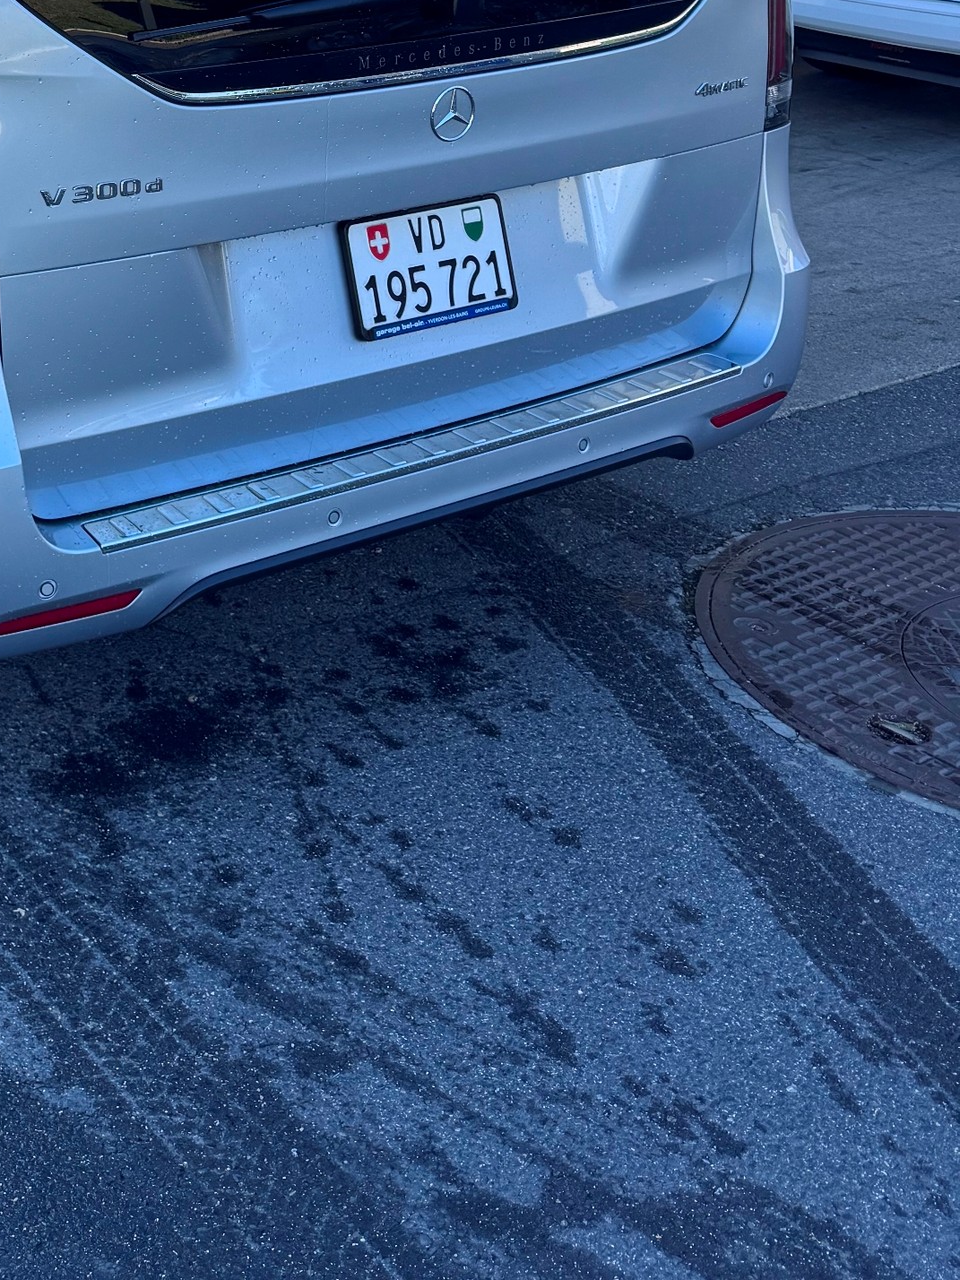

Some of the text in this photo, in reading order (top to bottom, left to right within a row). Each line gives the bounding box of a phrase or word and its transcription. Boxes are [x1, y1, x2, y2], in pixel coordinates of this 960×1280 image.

[358, 33, 545, 70] Mercedes-Benz
[695, 76, 749, 97] 4MATIC
[408, 214, 446, 254] VD
